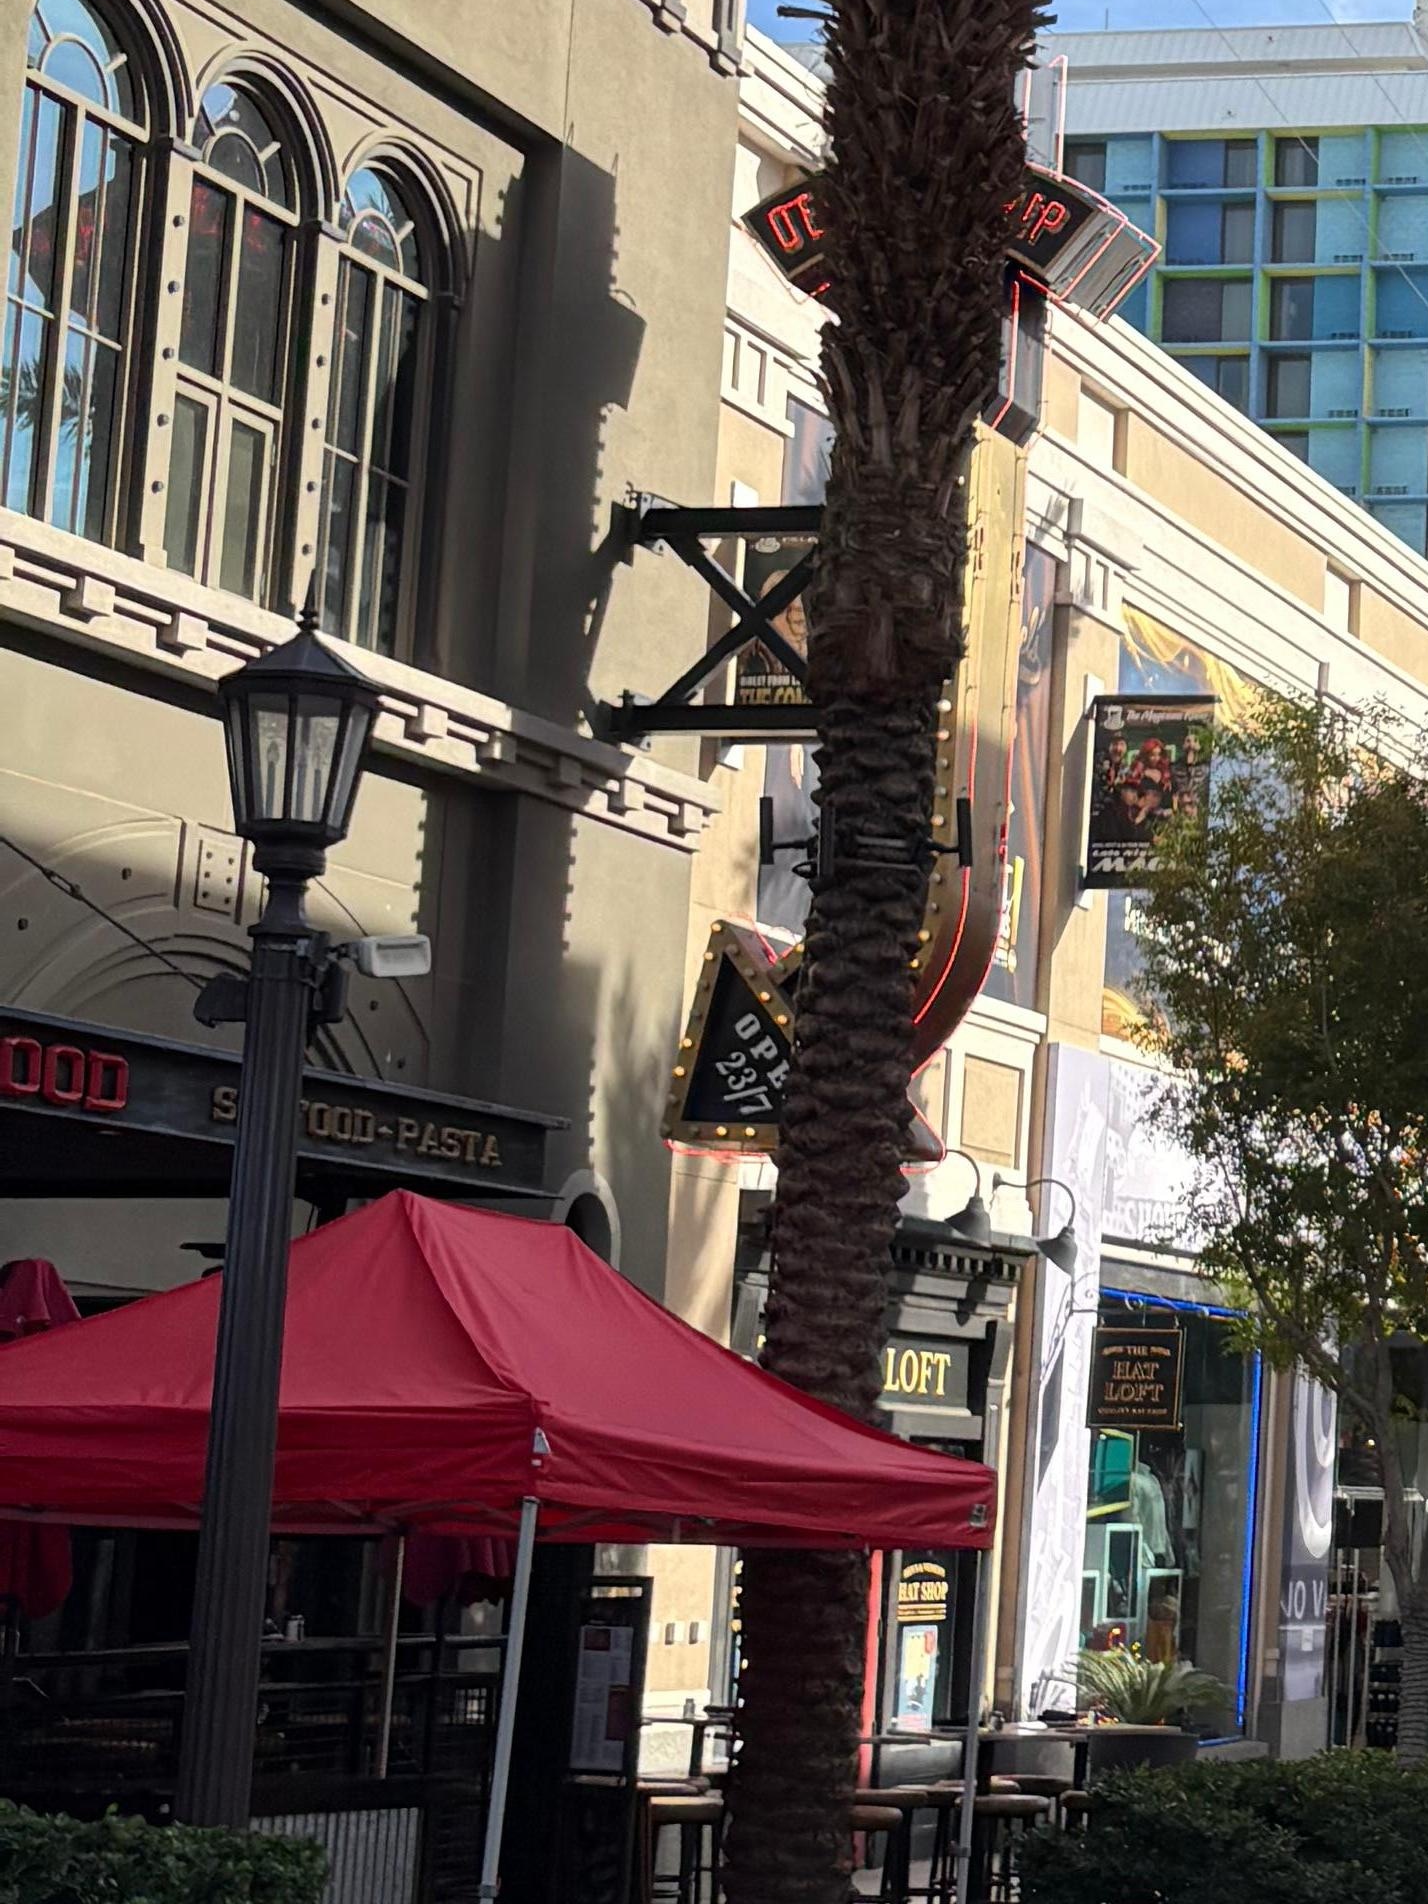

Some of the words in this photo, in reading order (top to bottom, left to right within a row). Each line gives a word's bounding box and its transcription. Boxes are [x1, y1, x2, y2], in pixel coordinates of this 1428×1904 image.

[734, 1012, 791, 1089] OPE
[715, 1051, 773, 1115] 23/7
[398, 1117, 502, 1167] PASTA
[883, 1347, 952, 1396] LOFT
[1103, 1382, 1164, 1402] LOFT
[1112, 1360, 1159, 1380] HAT
[921, 1581, 949, 1601] SHOP
